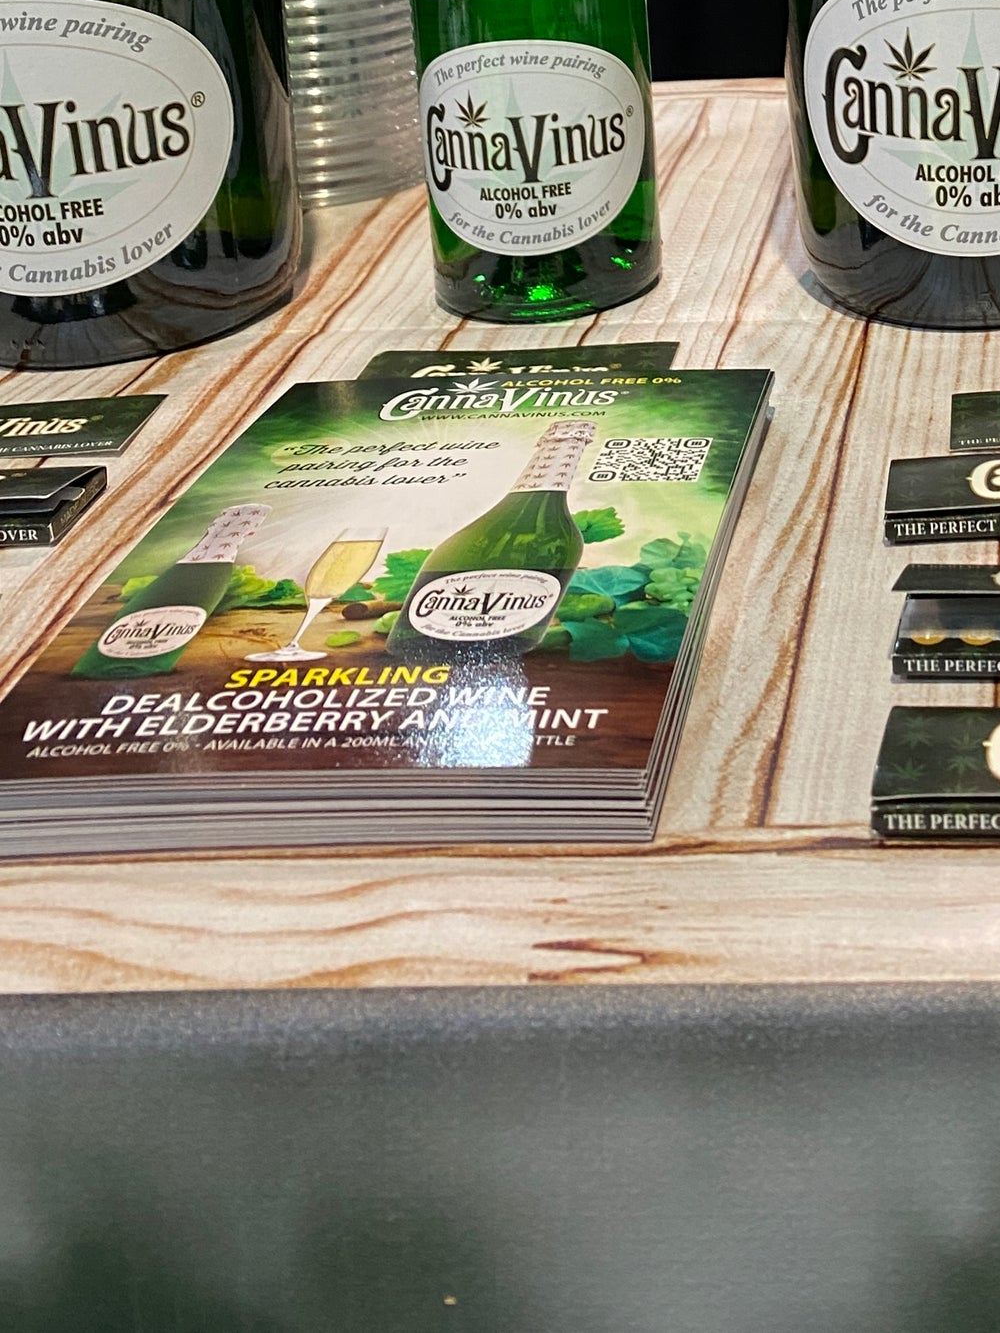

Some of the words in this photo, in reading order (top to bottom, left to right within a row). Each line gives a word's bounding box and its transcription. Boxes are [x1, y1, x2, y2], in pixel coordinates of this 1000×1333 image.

[1, 12, 57, 32] wine
[60, 18, 152, 53] pairing
[915, 164, 996, 183] ALCOHOL
[480, 186, 538, 202] ALCOHOL
[542, 182, 571, 198] FREE
[936, 185, 972, 207] 0%
[0, 201, 57, 222] OHOL
[61, 198, 104, 220] FREE
[495, 203, 522, 219] 0%
[529, 201, 557, 217] abv
[864, 194, 898, 219] for
[900, 212, 934, 238] the
[0, 225, 35, 246] 0%
[43, 222, 83, 245] abv
[9, 255, 116, 283] Cannabis
[121, 223, 173, 265] lover
[502, 379, 594, 388] ALCOHOL
[601, 377, 647, 385] FREE
[652, 376, 681, 385] 0%
[342, 441, 438, 457] perfect
[439, 440, 500, 451] wine
[278, 460, 378, 474] pairing
[375, 458, 424, 472] for
[429, 457, 468, 468] the
[264, 474, 379, 489] cannabis
[0, 530, 38, 541] OVER
[894, 522, 926, 537] THE
[929, 519, 998, 535] PERFECT
[224, 665, 450, 689] SPARKLING
[100, 687, 437, 716] DEALCOHOLIZED
[449, 686, 550, 708] WINE
[22, 716, 131, 742] WITH
[135, 710, 395, 737] ELDERBERRY
[398, 709, 472, 731] AN
[508, 708, 609, 730] MINT
[26, 743, 113, 758] ALCOHOL
[115, 740, 161, 754] FREE
[203, 736, 299, 751] AVAILABLE
[302, 736, 322, 748] IN
[324, 736, 337, 747] A
[341, 735, 399, 748] 200ML
[883, 814, 925, 831] THE
